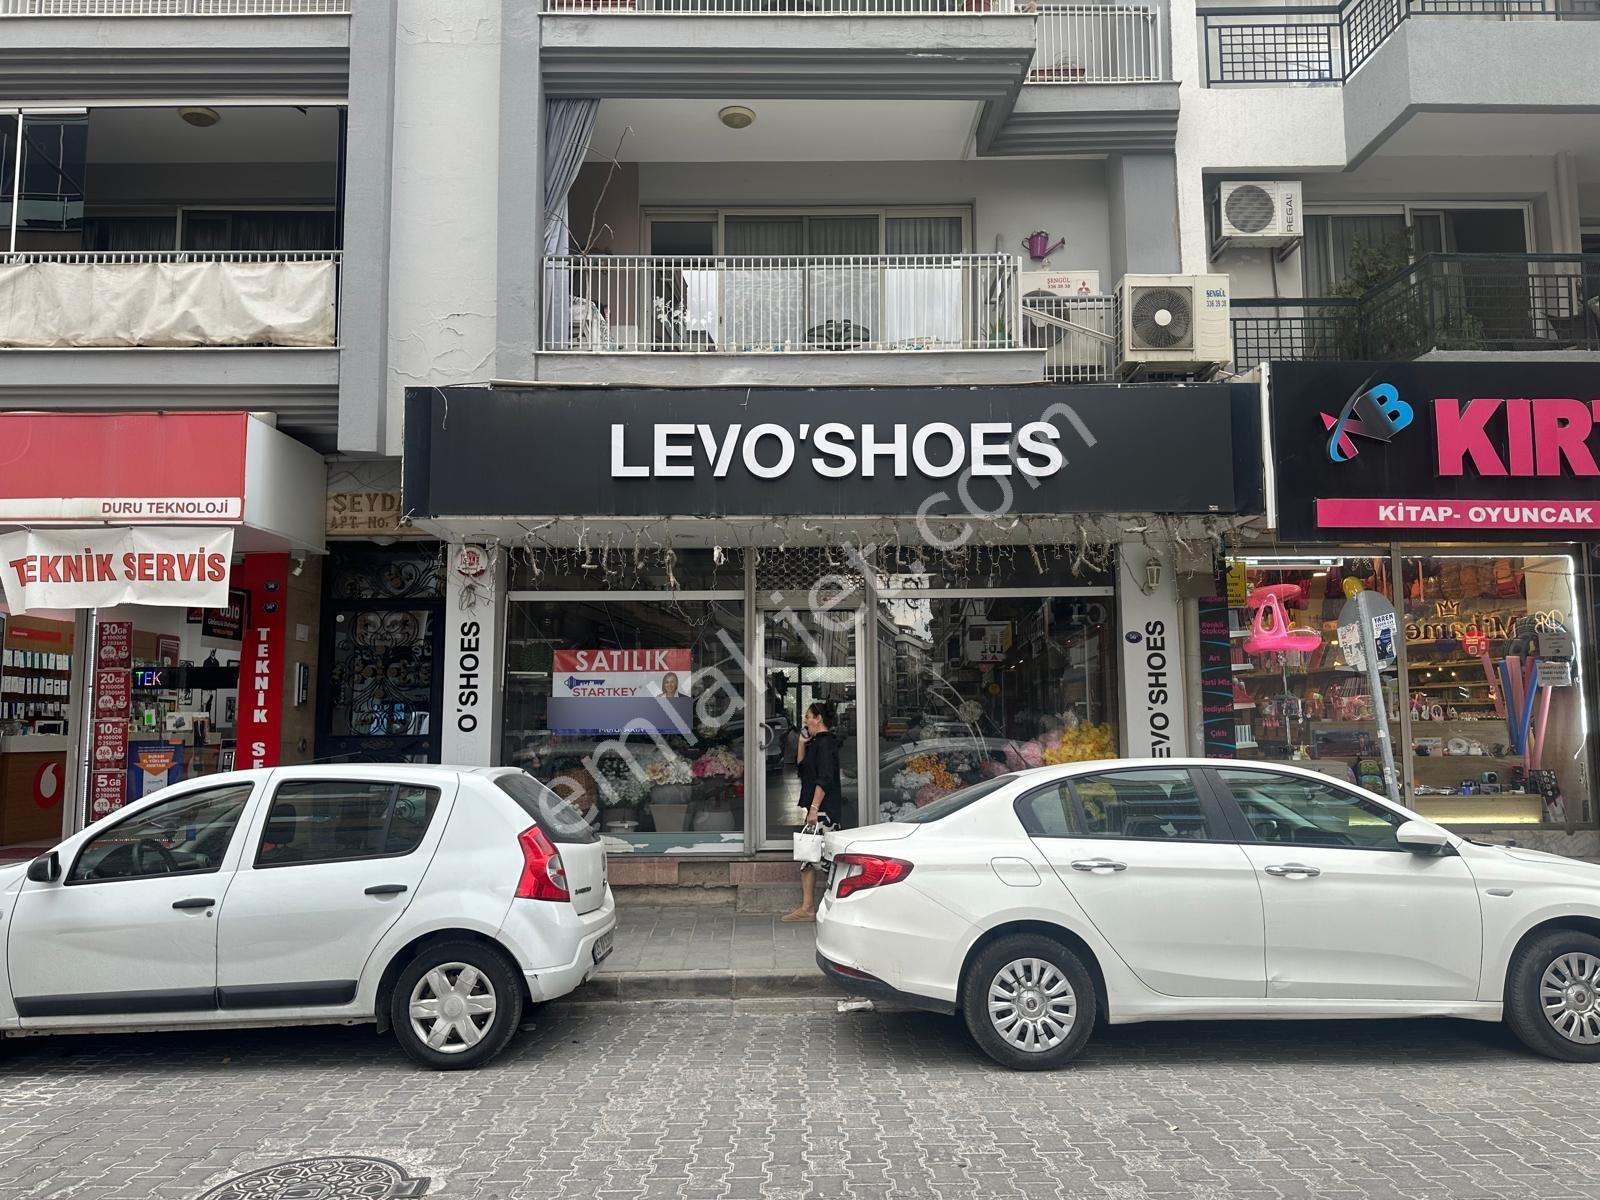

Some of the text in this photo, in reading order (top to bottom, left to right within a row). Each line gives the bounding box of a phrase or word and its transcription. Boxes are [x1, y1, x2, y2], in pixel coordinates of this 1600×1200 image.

[1285, 193, 1293, 232] REGAL
[1434, 398, 1600, 477] KIR
[611, 421, 1063, 479] LEVO'SHOES
[102, 499, 228, 515] DURU TEKNOLOJİ
[333, 493, 401, 515] ŞEYD
[1378, 502, 1594, 523] KİTAP- OYUNCAK
[9, 547, 226, 588] TEKNİK SERVİS
[1200, 627, 1228, 635] otokopi
[575, 650, 669, 672] SATILIK
[135, 671, 162, 686] TEK
[252, 628, 271, 723] TEKNİK
[457, 621, 481, 733] O'SHOES
[572, 687, 638, 697] STARTKEY
